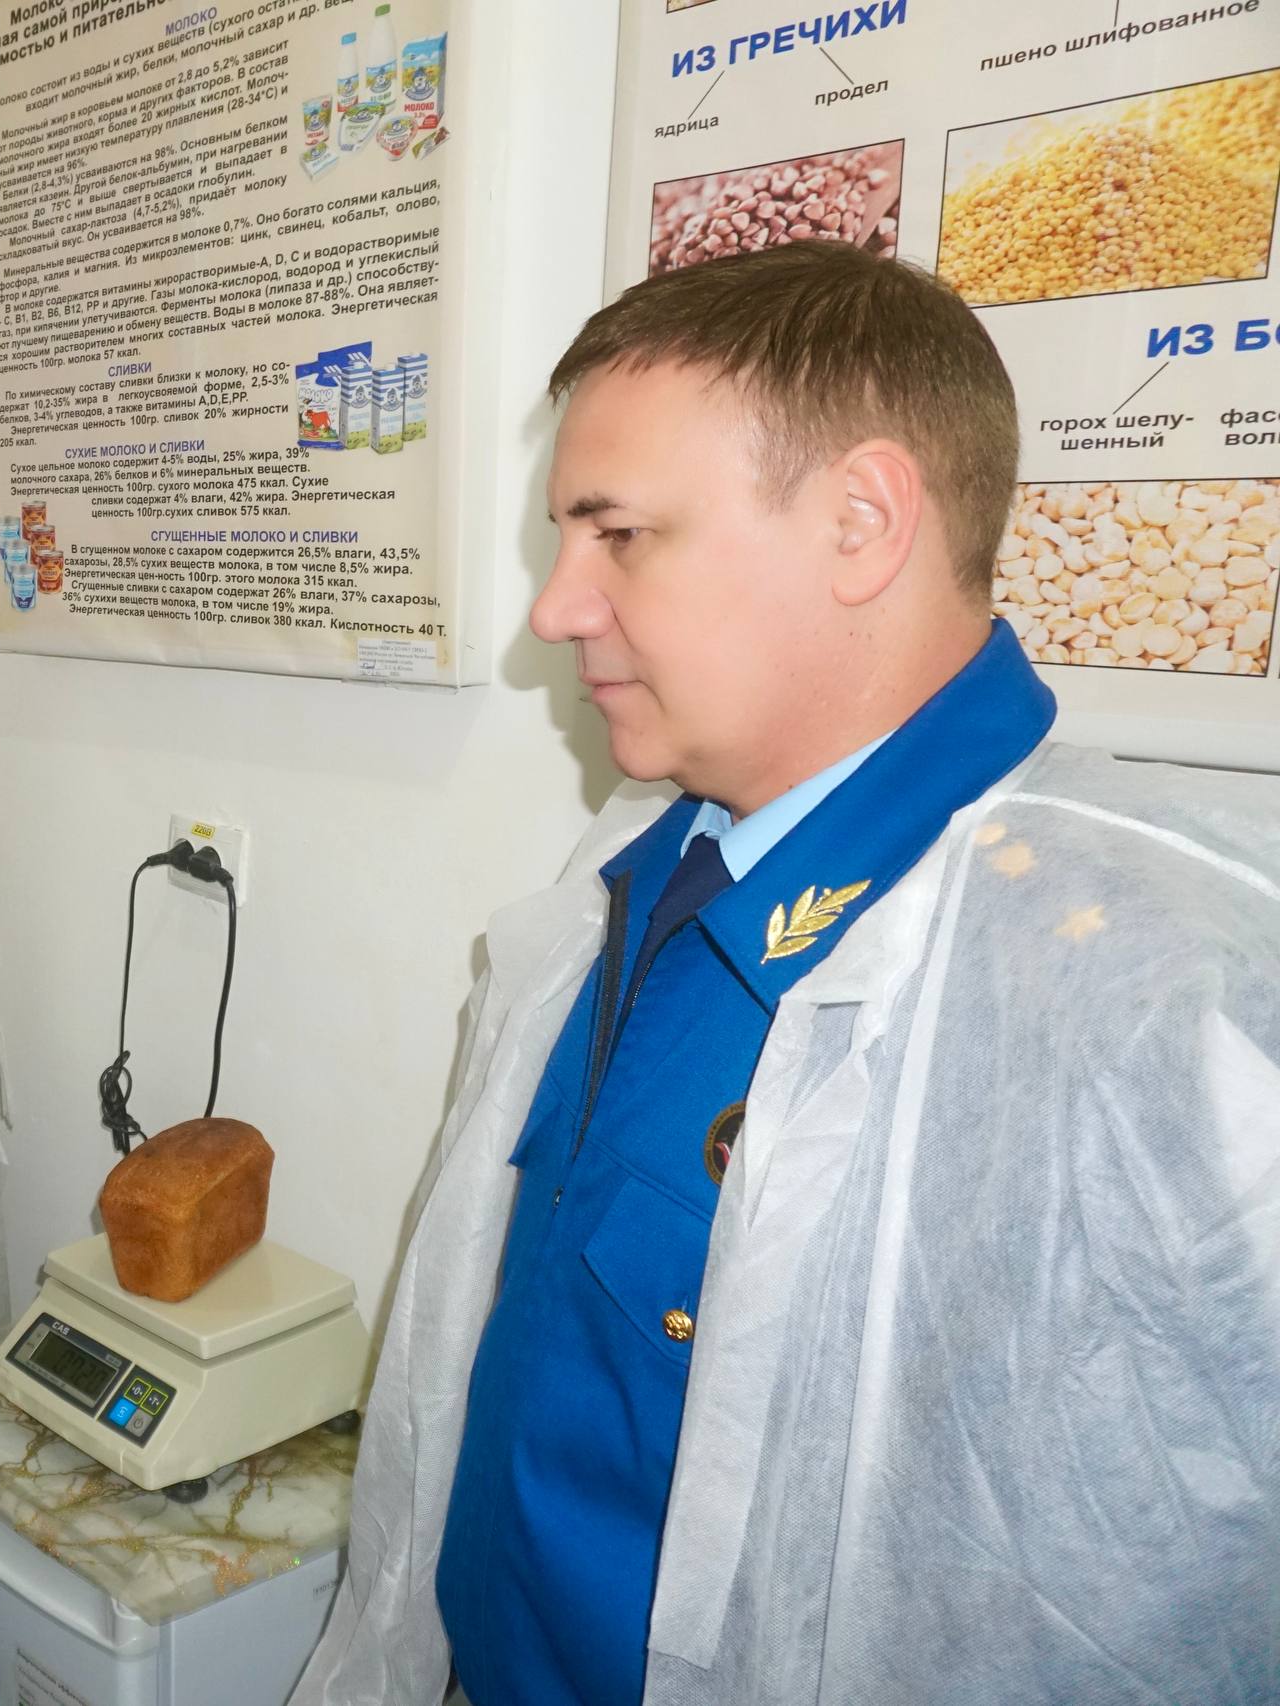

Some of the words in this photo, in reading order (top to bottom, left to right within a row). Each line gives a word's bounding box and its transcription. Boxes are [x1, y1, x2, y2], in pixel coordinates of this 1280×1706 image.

[23, 8, 68, 39] самой
[165, 6, 218, 36] МОЛОКО
[59, 29, 69, 43] и
[672, 45, 716, 78] ИЗ
[728, 0, 908, 65] ГРЕЧИХИ
[980, 44, 1057, 71] пшено
[1065, 0, 1260, 52] шлифованное
[815, 80, 889, 106] продел
[654, 116, 719, 138] ядрица
[3, 187, 29, 200] Белки
[75, 158, 138, 183] усваиваются
[140, 154, 152, 164] на
[154, 145, 178, 160] 98%.
[180, 129, 242, 153] Основным
[245, 116, 288, 135] белком
[3, 258, 64, 278] Минеральные
[66, 249, 111, 265] вещества
[112, 236, 170, 255] содержится
[172, 234, 179, 243] в
[181, 226, 221, 241] молоке
[223, 218, 253, 233] 0,7%.
[256, 214, 280, 226] Оно
[283, 204, 324, 220] богато
[327, 193, 377, 211] солями
[381, 180, 441, 200] кальция,
[11, 348, 50, 361] хорошим
[54, 337, 125, 356] растворителем
[129, 332, 164, 344] многих
[168, 322, 226, 338] составных
[231, 313, 271, 329] частей
[276, 308, 325, 322] молока.
[331, 293, 438, 315] Энергетическая
[1147, 325, 1214, 358] ИЗ
[1235, 318, 1280, 352] Б
[108, 363, 152, 377] СЛИВКИ
[1039, 415, 1106, 434] горох
[1116, 413, 1195, 431] шелу-
[1220, 408, 1280, 428] фас
[65, 448, 98, 459] СУХИЕ
[100, 445, 146, 457] МОЛОКО
[149, 444, 157, 454] И
[159, 440, 205, 453] СЛИВКИ
[1061, 433, 1165, 451] шенный
[1225, 432, 1280, 446] вол
[10, 463, 36, 475] Сухое
[38, 462, 75, 473] цельное
[78, 460, 111, 469] молоко
[113, 458, 159, 469] содержит
[161, 455, 184, 465] 4-5%
[187, 455, 220, 465] воды,
[223, 451, 246, 462] 25%
[249, 452, 282, 463] жира,
[286, 448, 310, 459] 39%
[10, 475, 57, 484] молочного
[58, 474, 92, 483] сахара,
[94, 471, 112, 481] 26%
[114, 470, 149, 480] белков
[160, 468, 174, 478] 6%
[177, 467, 254, 479] минеральных
[257, 464, 311, 475] веществ.
[11, 486, 80, 498] Энергетическая
[82, 485, 124, 495] ценность
[127, 482, 155, 494] 100гр.
[158, 482, 190, 493] сухого
[193, 481, 234, 490] молока
[237, 478, 257, 488] 475
[260, 479, 289, 488] ккал.
[292, 476, 329, 489] Сухие
[91, 497, 124, 505] сливки
[126, 496, 172, 506] содержат
[174, 493, 188, 503] 4%
[191, 495, 227, 504] влаги,
[229, 492, 253, 502] 42%
[256, 494, 288, 504] жира.
[291, 491, 395, 503] Энергетическая
[92, 509, 134, 519] ценность
[137, 507, 194, 519] 100гр.сухих
[196, 508, 238, 516] сливок
[240, 506, 260, 516] 575
[262, 507, 291, 516] ккал.
[151, 532, 227, 543] СГУЩЕННЫЕ
[231, 532, 286, 542] МОЛОКО
[290, 532, 299, 542] И
[302, 532, 358, 543] СЛИВКИ
[71, 544, 78, 553] В
[80, 546, 130, 556] сгущенном
[133, 547, 167, 555] молоке
[176, 548, 223, 558] сахаром
[226, 548, 294, 559] содержится
[298, 547, 331, 560] 26,5%
[335, 550, 375, 561] влаги,
[379, 548, 420, 561] 43,5%
[64, 558, 110, 568] сахарозы,
[113, 557, 139, 569] 28,5%
[141, 560, 168, 570] сухих
[170, 560, 215, 570] веществ
[218, 561, 263, 572] молока,
[266, 563, 273, 571] в
[276, 563, 298, 571] том
[301, 563, 336, 572] числе
[339, 562, 369, 575] 8,5%
[373, 565, 413, 577] жира.
[64, 568, 136, 580] Энергетическая
[138, 572, 185, 581] цен-ность
[188, 572, 221, 585] 100гр.
[225, 575, 255, 584] этого
[258, 576, 300, 585] молока
[304, 575, 324, 586] 315
[327, 578, 358, 587] ккал.
[62, 591, 81, 601] 36%
[84, 594, 117, 604] сухихи
[119, 596, 159, 606] веществ
[161, 598, 199, 609] молока,
[202, 600, 209, 608] в
[212, 600, 233, 609] том
[236, 601, 269, 611] числе
[272, 601, 295, 612] 19%
[298, 605, 334, 617] жира.
[71, 580, 124, 592] Сгущенные
[126, 584, 159, 593] сливки
[161, 585, 167, 593] с
[169, 586, 214, 597] сахаром
[217, 587, 270, 599] содержат
[273, 587, 297, 599] 26%
[300, 591, 338, 602] влаги,
[341, 590, 367, 602] 37%
[371, 594, 441, 608] сахарозы,
[69, 603, 145, 617] Энергетическая
[147, 610, 191, 620] ценность
[194, 610, 227, 624] 100гр.
[230, 614, 271, 624] сливок
[273, 615, 292, 626] 380
[295, 618, 326, 628] ккал.
[330, 618, 415, 634] Кислотность
[418, 624, 434, 635] 40
[437, 625, 447, 636] Т.
[51, 1321, 70, 1336] CAS
